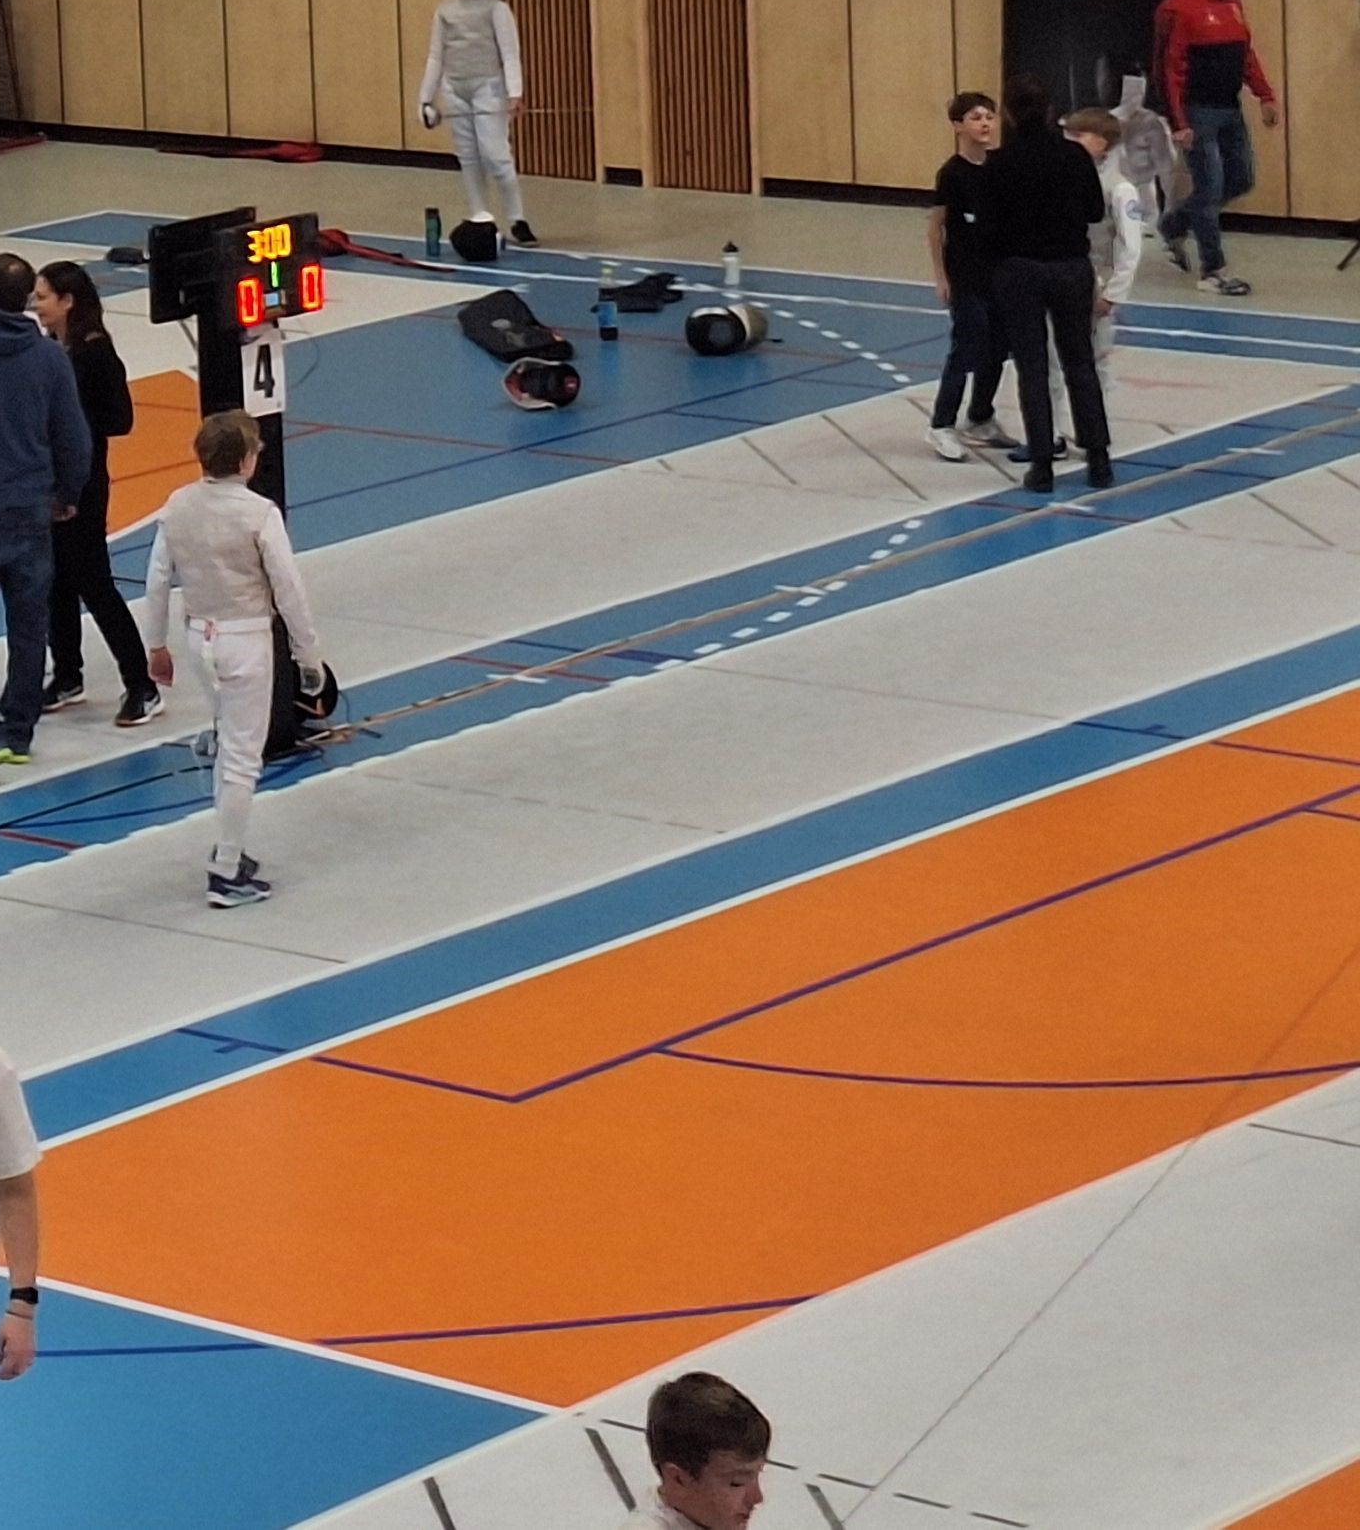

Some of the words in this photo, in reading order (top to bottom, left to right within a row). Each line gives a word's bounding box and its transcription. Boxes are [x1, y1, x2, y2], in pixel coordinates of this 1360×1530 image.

[237, 278, 260, 324] 0
[301, 264, 321, 311] 0
[253, 343, 276, 399] 4
